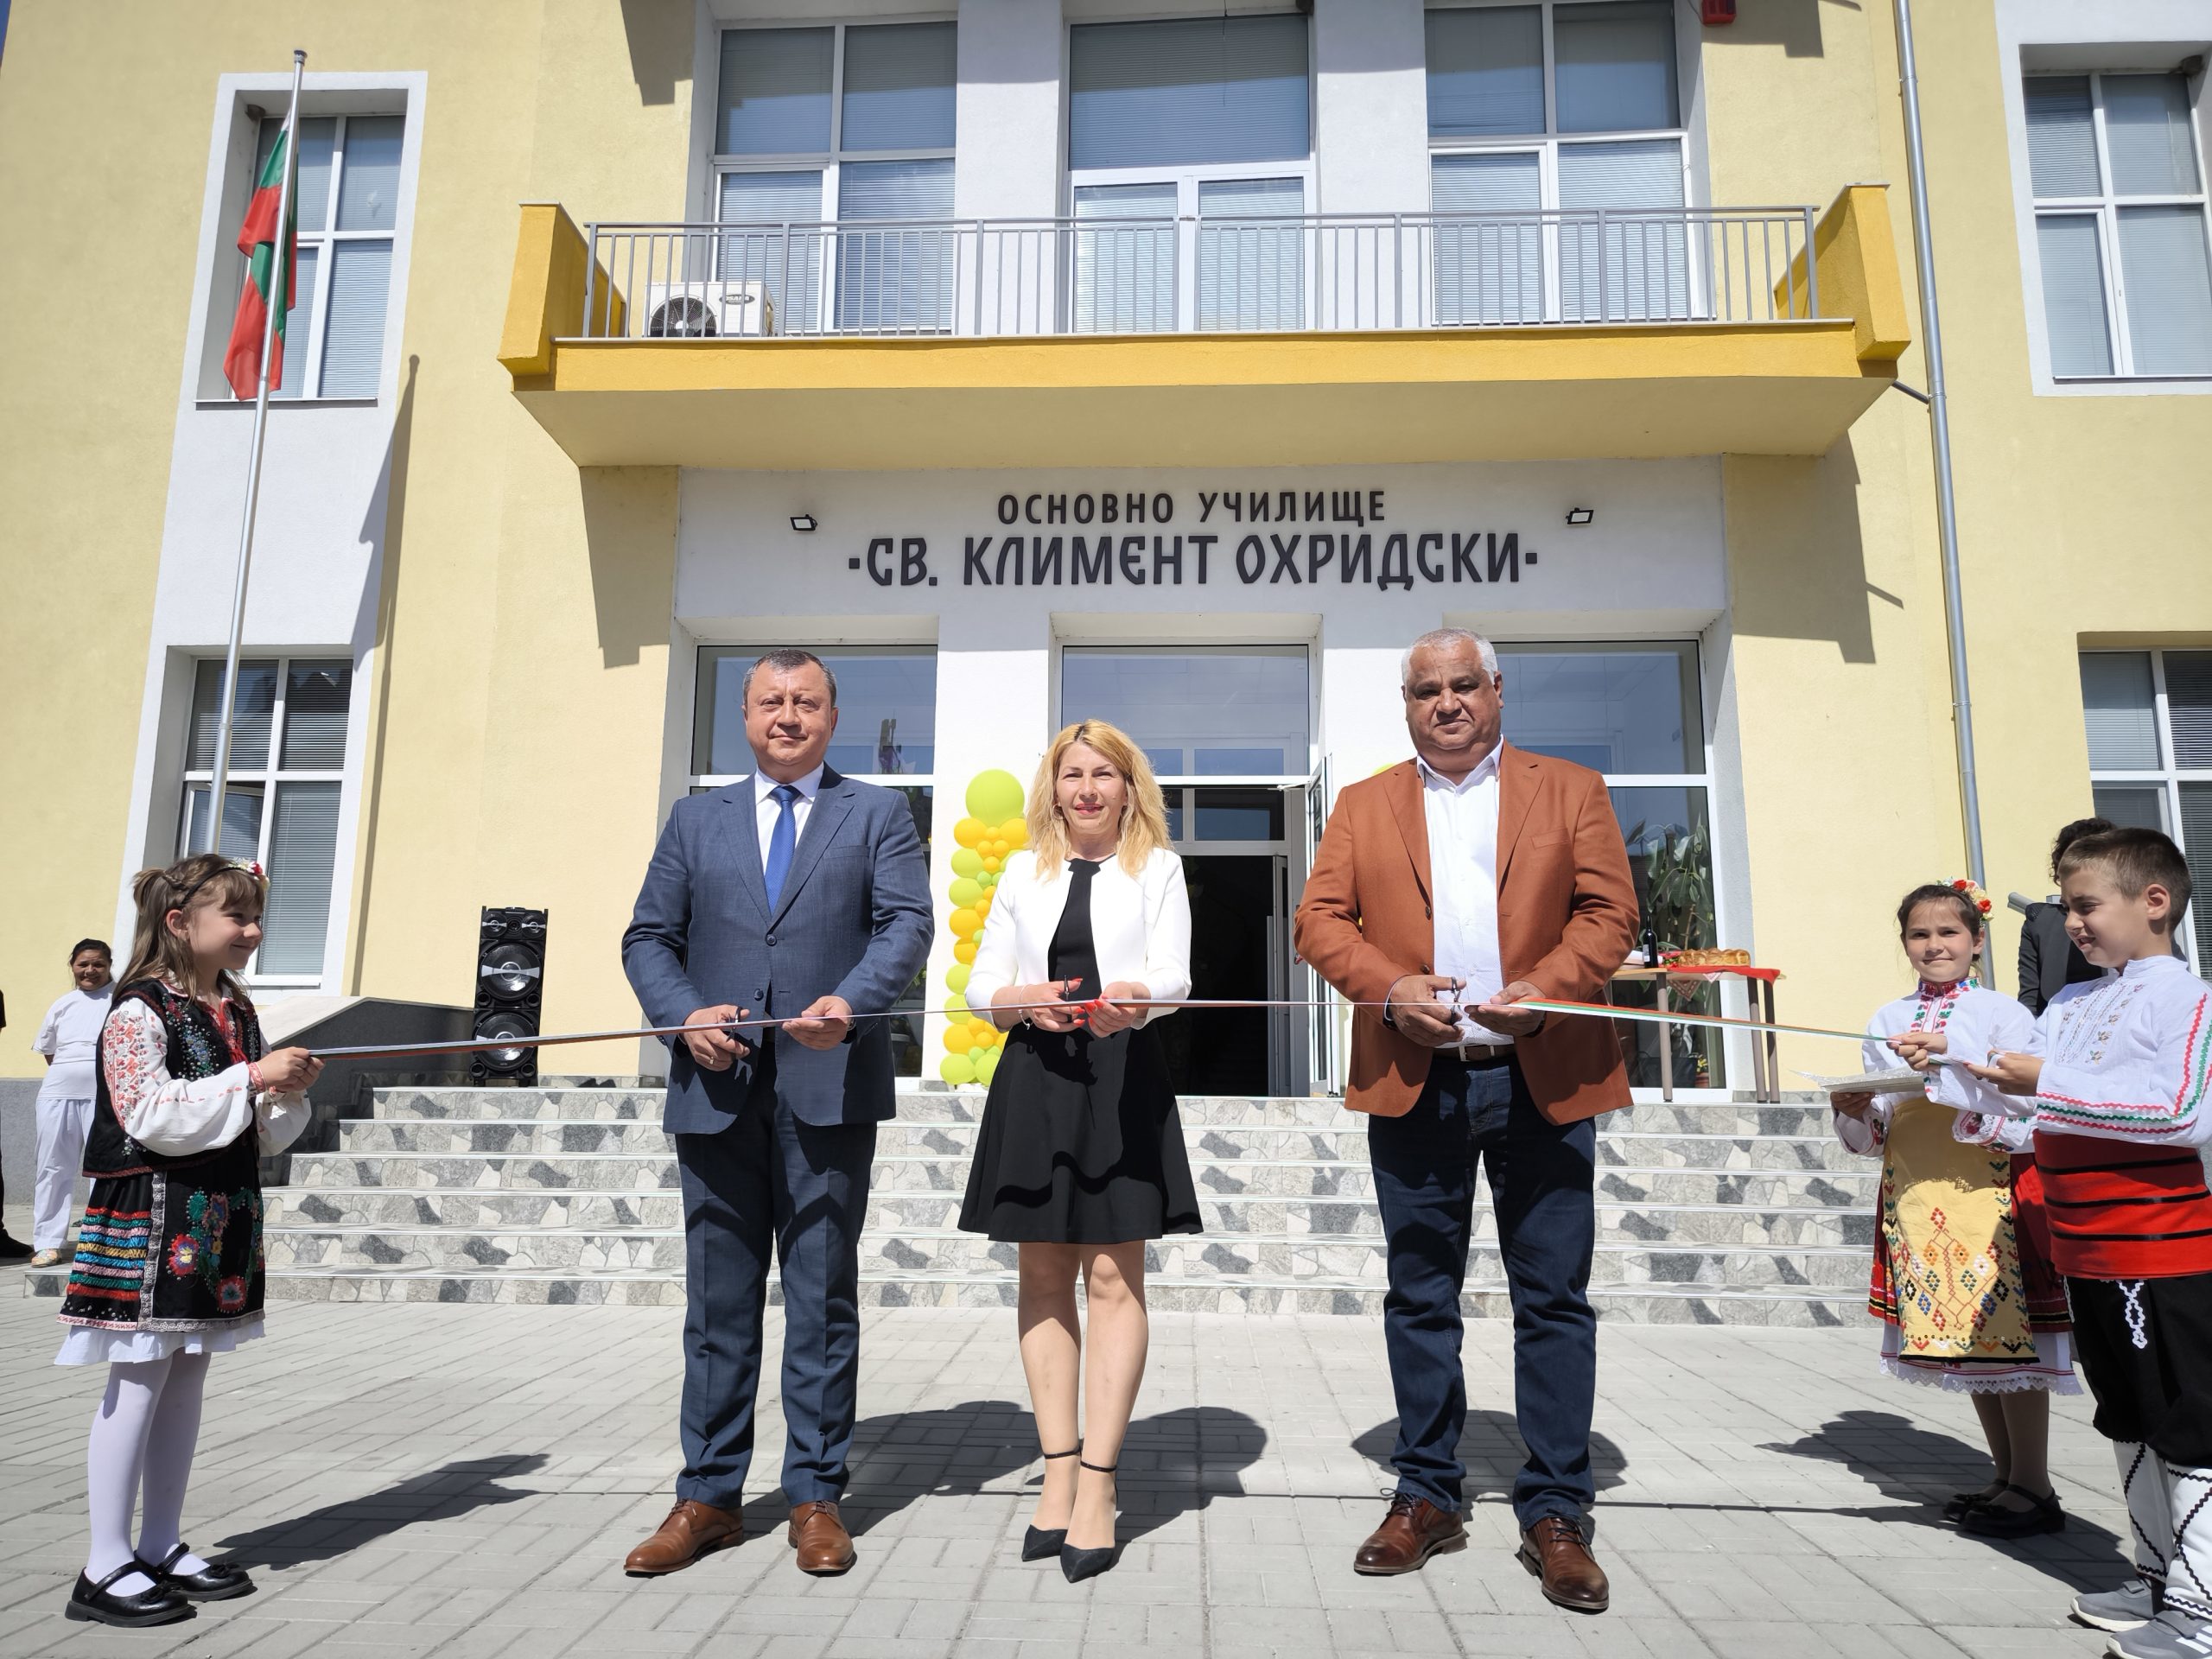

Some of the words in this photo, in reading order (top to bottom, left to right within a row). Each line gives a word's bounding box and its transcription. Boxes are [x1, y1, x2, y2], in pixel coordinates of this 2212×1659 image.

[998, 493, 1173, 524] ОСНОВНО
[1198, 491, 1385, 527] УЧИЛИЩЕ
[964, 535, 1218, 585] КЛИМЕНТ
